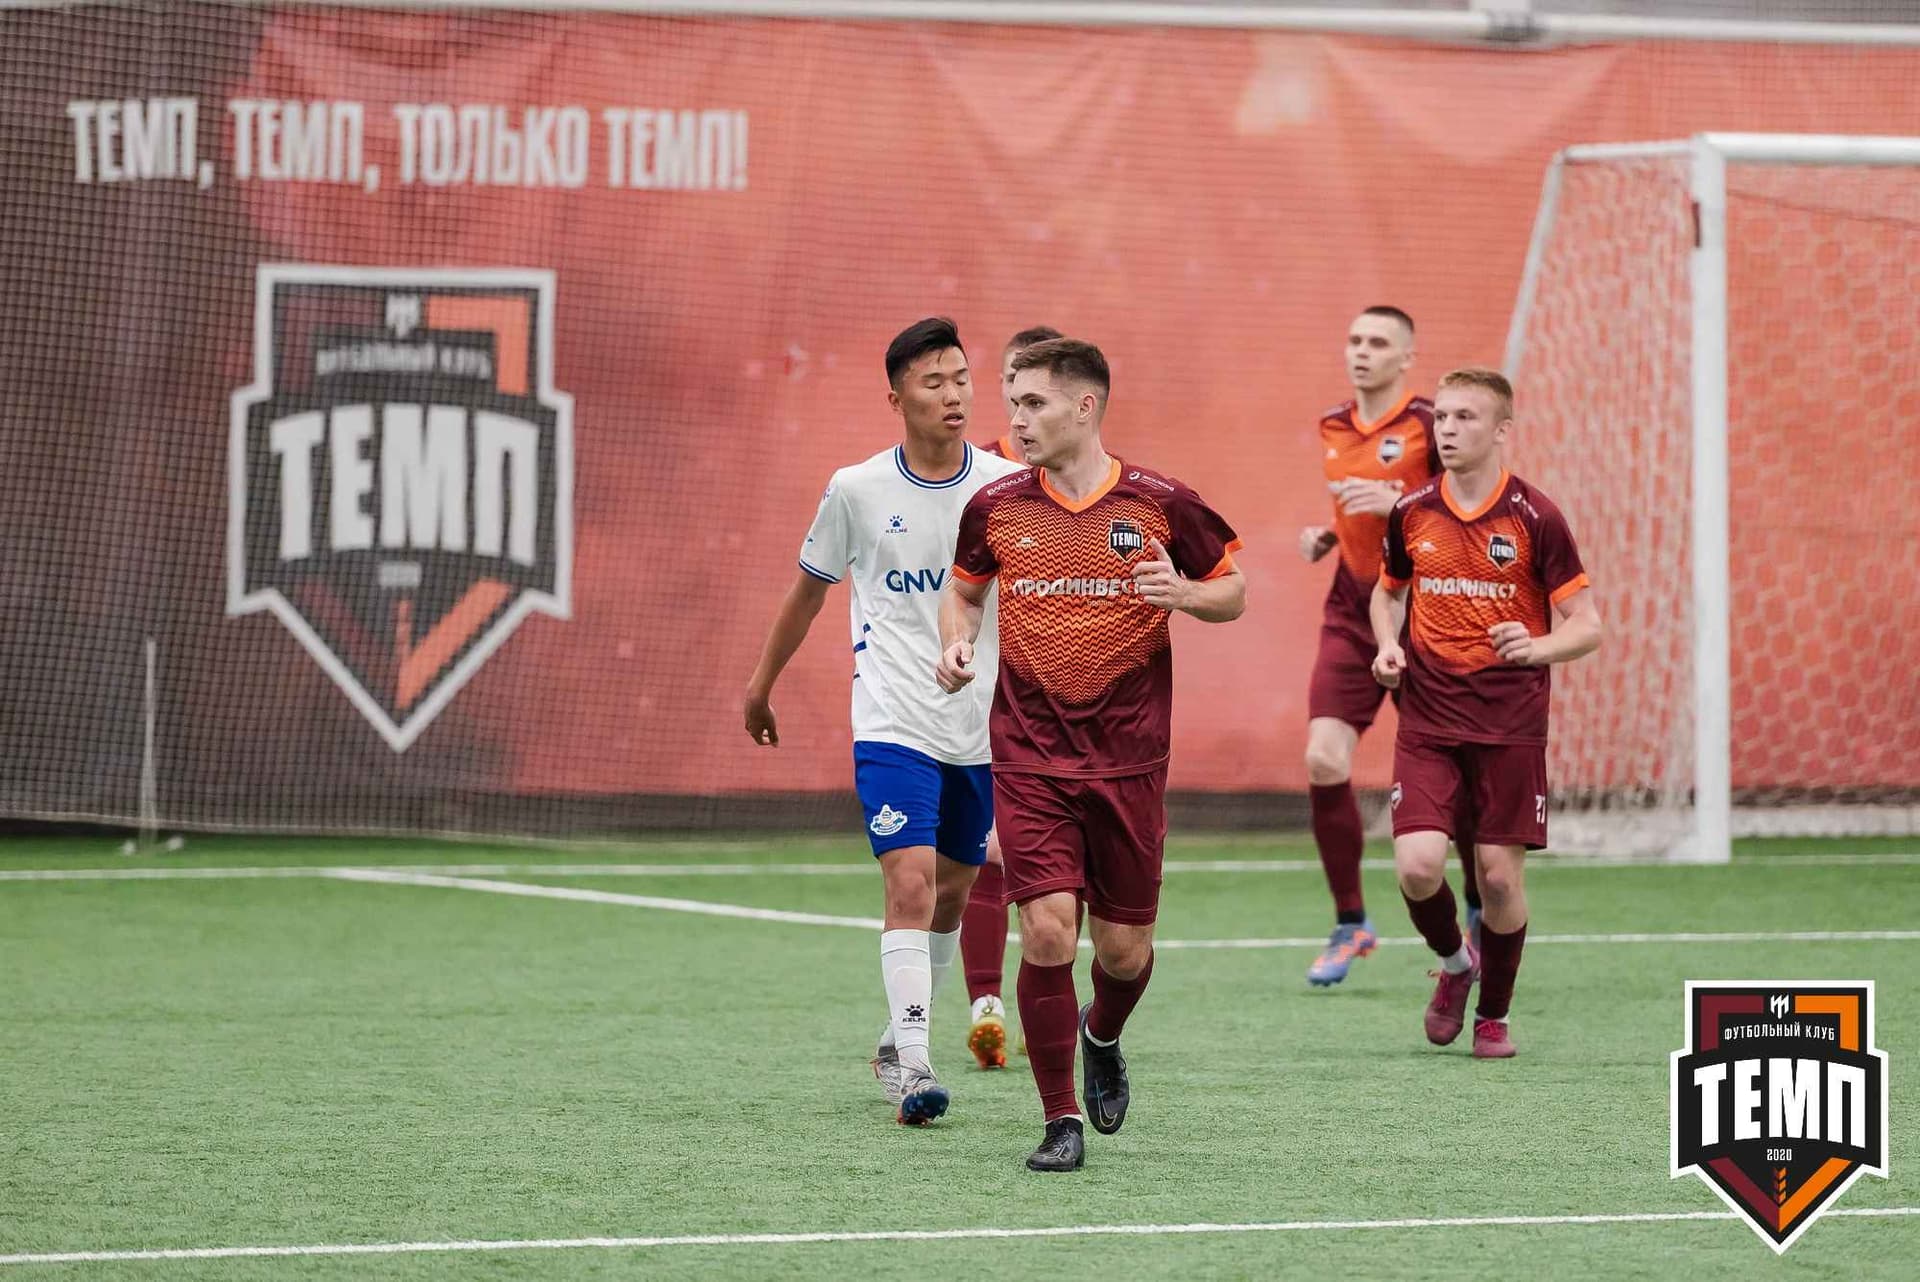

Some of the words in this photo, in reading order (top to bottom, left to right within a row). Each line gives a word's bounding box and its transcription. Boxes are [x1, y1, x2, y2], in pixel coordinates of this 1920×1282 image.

[66, 98, 214, 189] ТЕМП,
[228, 99, 380, 194] ТЕМП,
[394, 102, 590, 188] ТОЛЬКО
[603, 106, 748, 191] ТЕМП!
[269, 402, 539, 568] ТЕМП
[1111, 531, 1141, 549] ТЕМП
[885, 567, 946, 594] GNV
